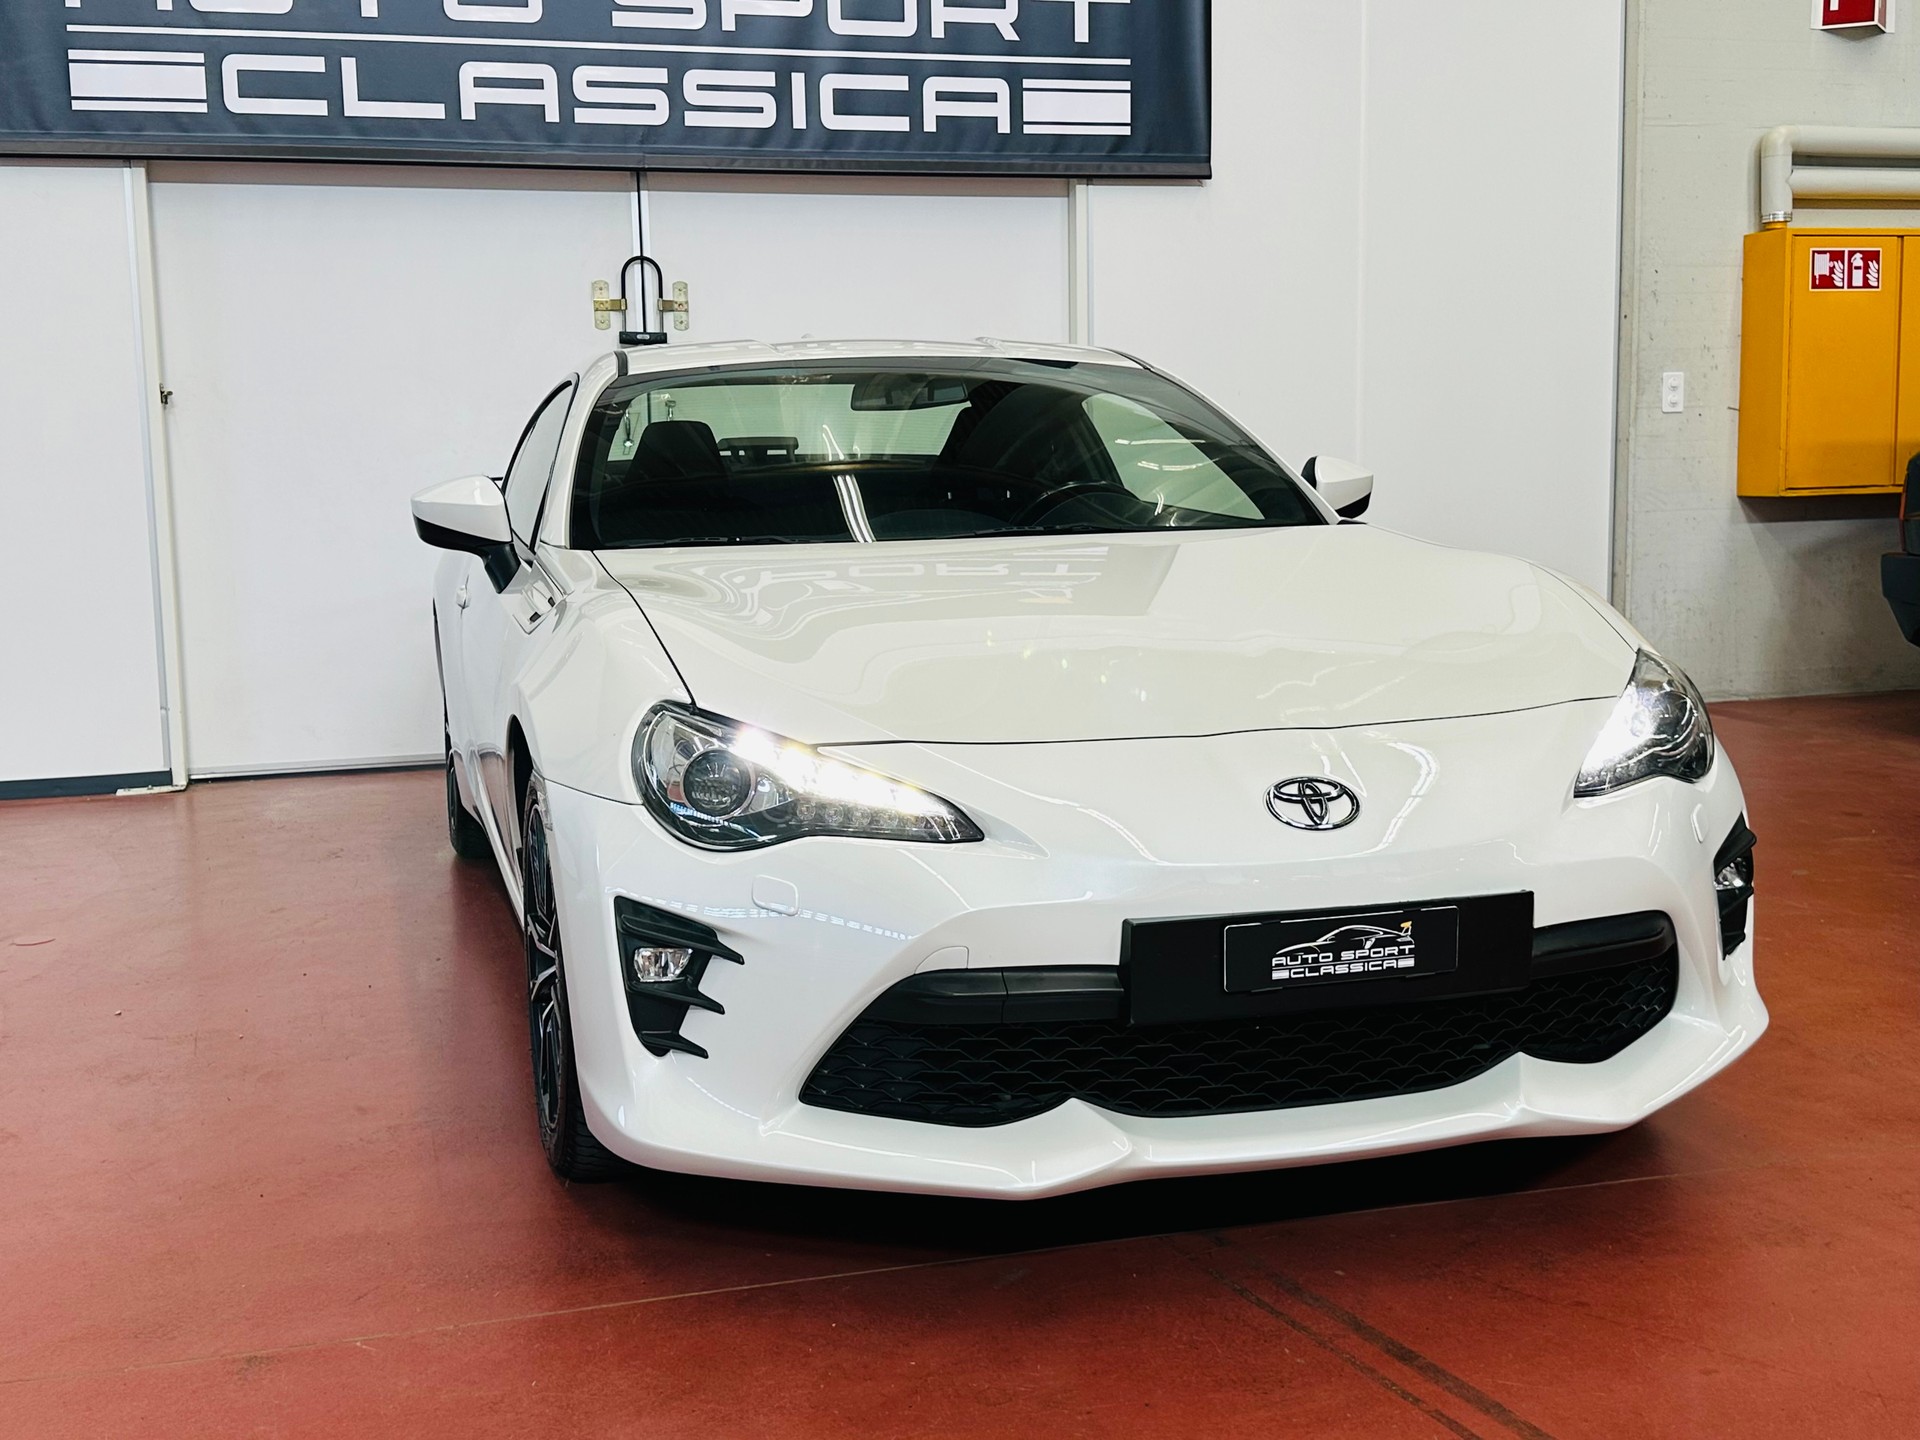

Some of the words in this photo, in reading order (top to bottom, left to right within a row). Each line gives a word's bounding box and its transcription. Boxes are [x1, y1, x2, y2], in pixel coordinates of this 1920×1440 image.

[221, 53, 1010, 134] CLASSICA
[1272, 952, 1333, 967] AUTO
[1341, 945, 1415, 961] SPORT
[1290, 959, 1397, 979] CLASSICA
